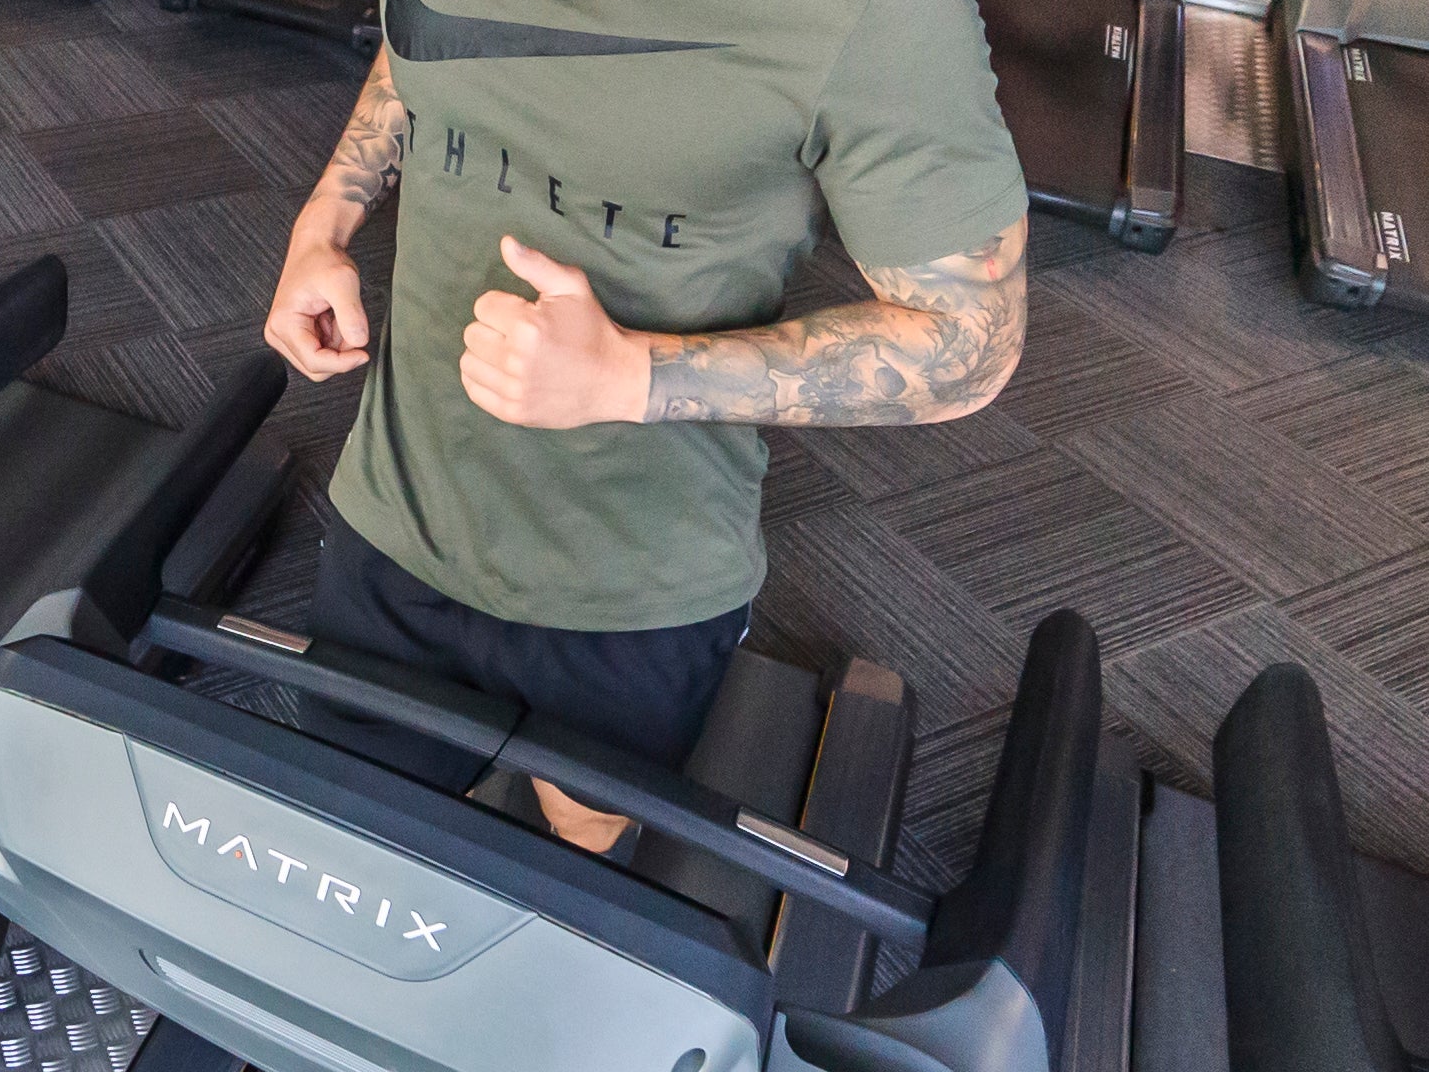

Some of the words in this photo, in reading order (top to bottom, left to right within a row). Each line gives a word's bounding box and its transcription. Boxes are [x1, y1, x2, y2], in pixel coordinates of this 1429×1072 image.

[1111, 26, 1123, 59] MATRIX
[1350, 48, 1367, 81] MATRIX
[1380, 211, 1403, 260] MATRIX
[163, 801, 448, 953] MATRIX
